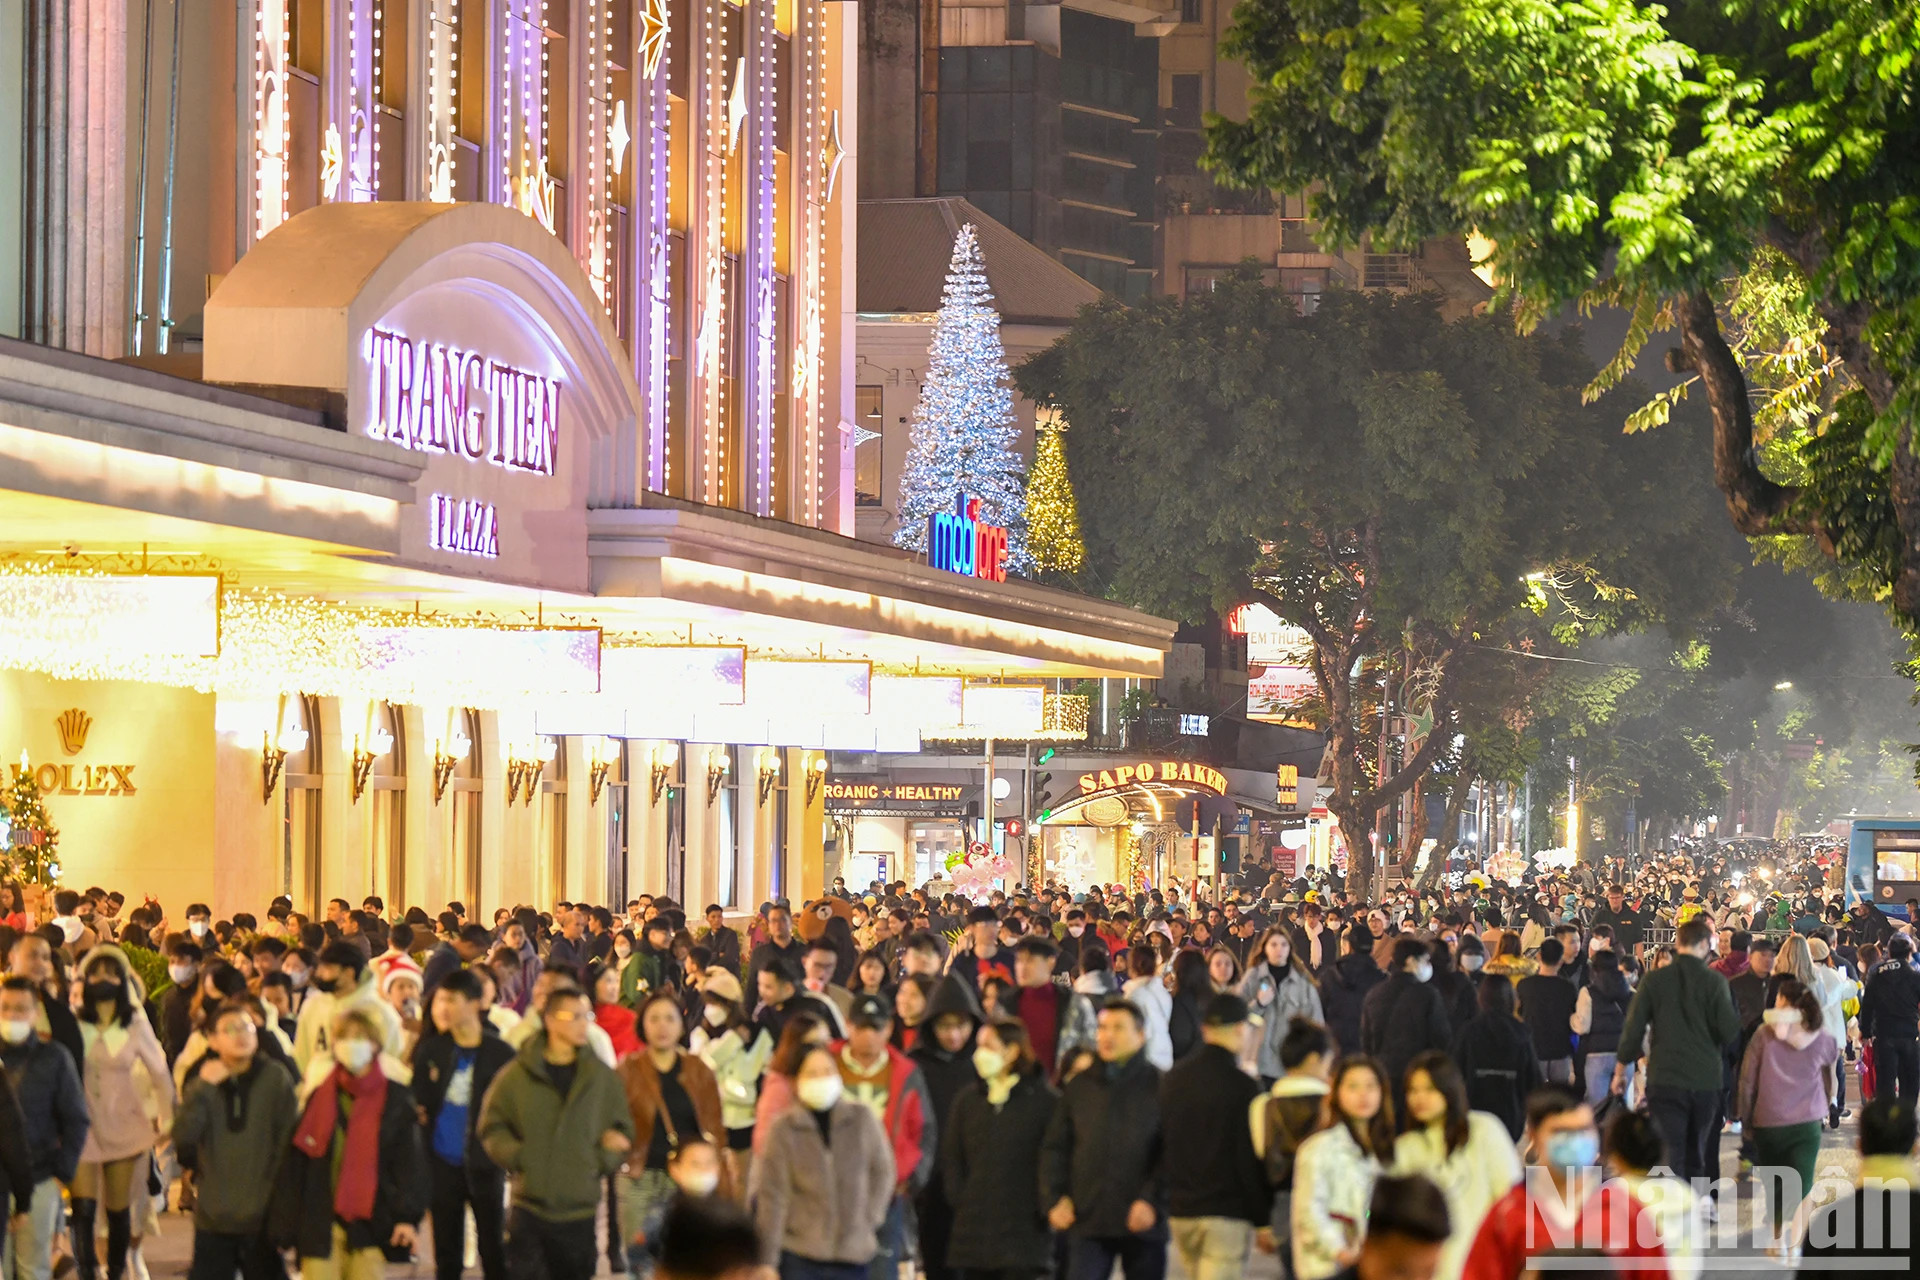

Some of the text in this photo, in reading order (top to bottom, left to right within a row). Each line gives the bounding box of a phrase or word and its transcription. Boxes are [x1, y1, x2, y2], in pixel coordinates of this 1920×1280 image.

[430, 494, 500, 558] PLAZA
[928, 493, 1009, 584] mobifone
[895, 786, 962, 800] HEALTHY
[1079, 762, 1155, 794] SAPO
[1160, 761, 1228, 796] BAKERY
